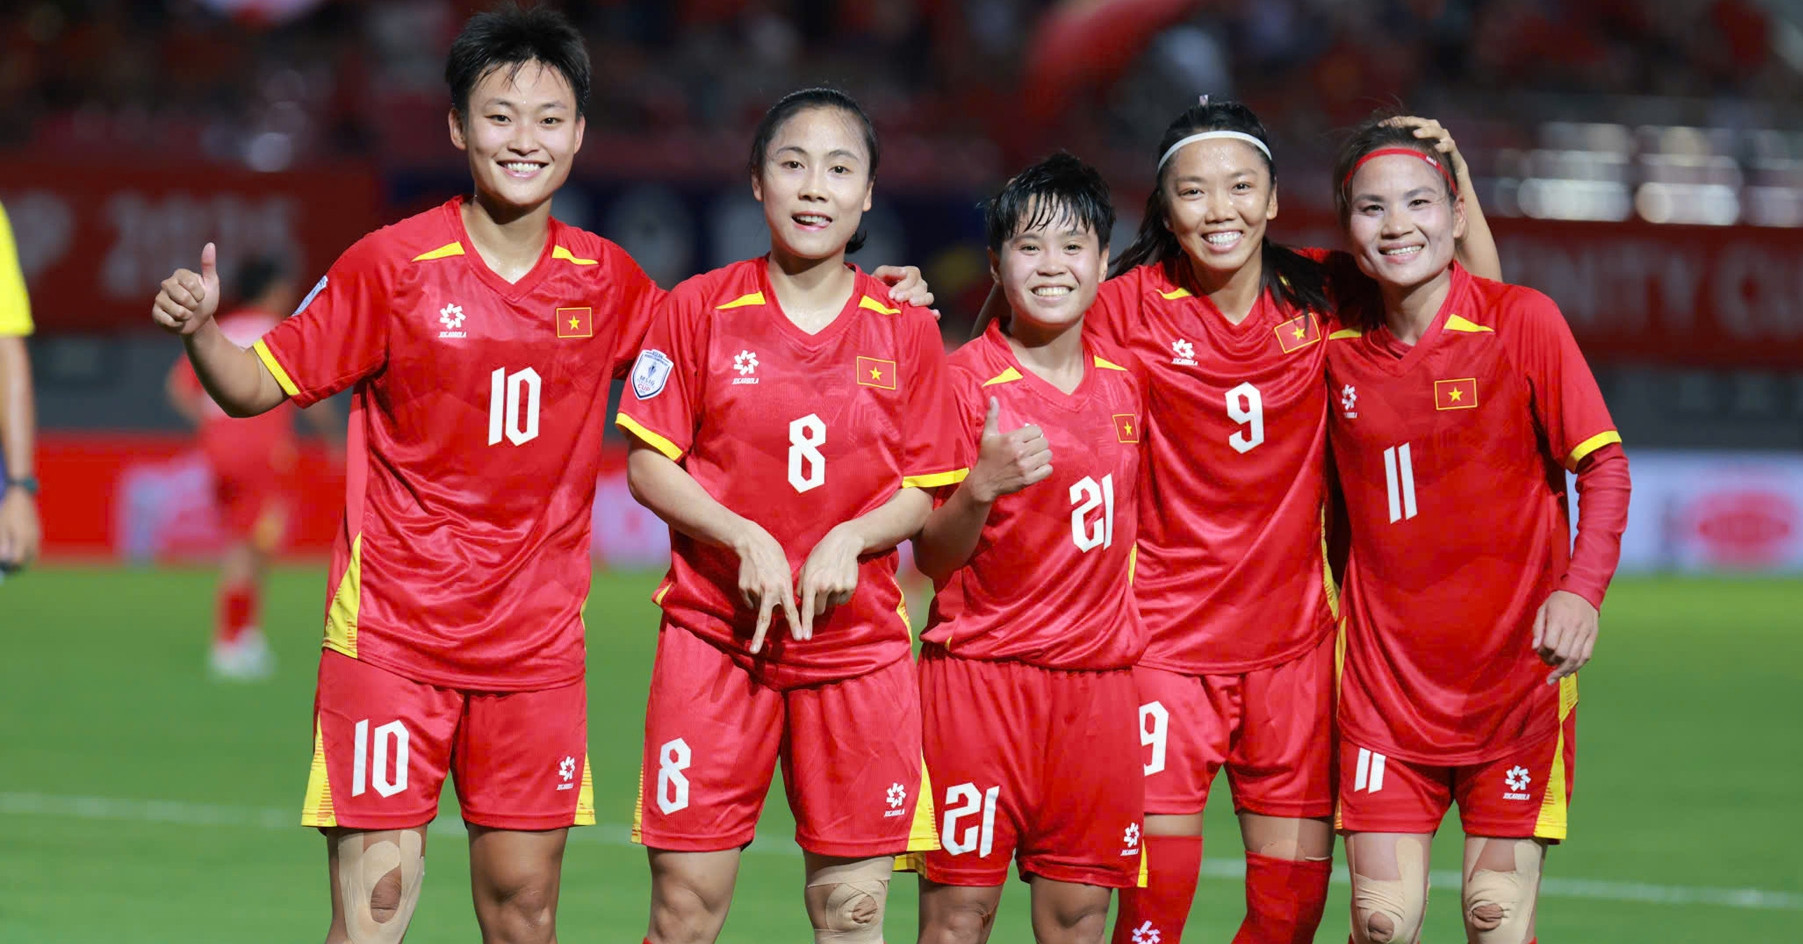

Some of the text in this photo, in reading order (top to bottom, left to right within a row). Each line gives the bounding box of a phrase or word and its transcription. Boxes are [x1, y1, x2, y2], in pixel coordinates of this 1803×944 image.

[488, 367, 541, 446] 10
[1225, 382, 1265, 453] 9
[788, 413, 827, 493] 8
[1383, 442, 1418, 523] 11
[1069, 473, 1115, 552] 21
[352, 719, 409, 798] 10
[657, 738, 691, 814] 8
[1139, 700, 1169, 776] 9
[1354, 747, 1386, 794] 11
[941, 782, 999, 857] 21
